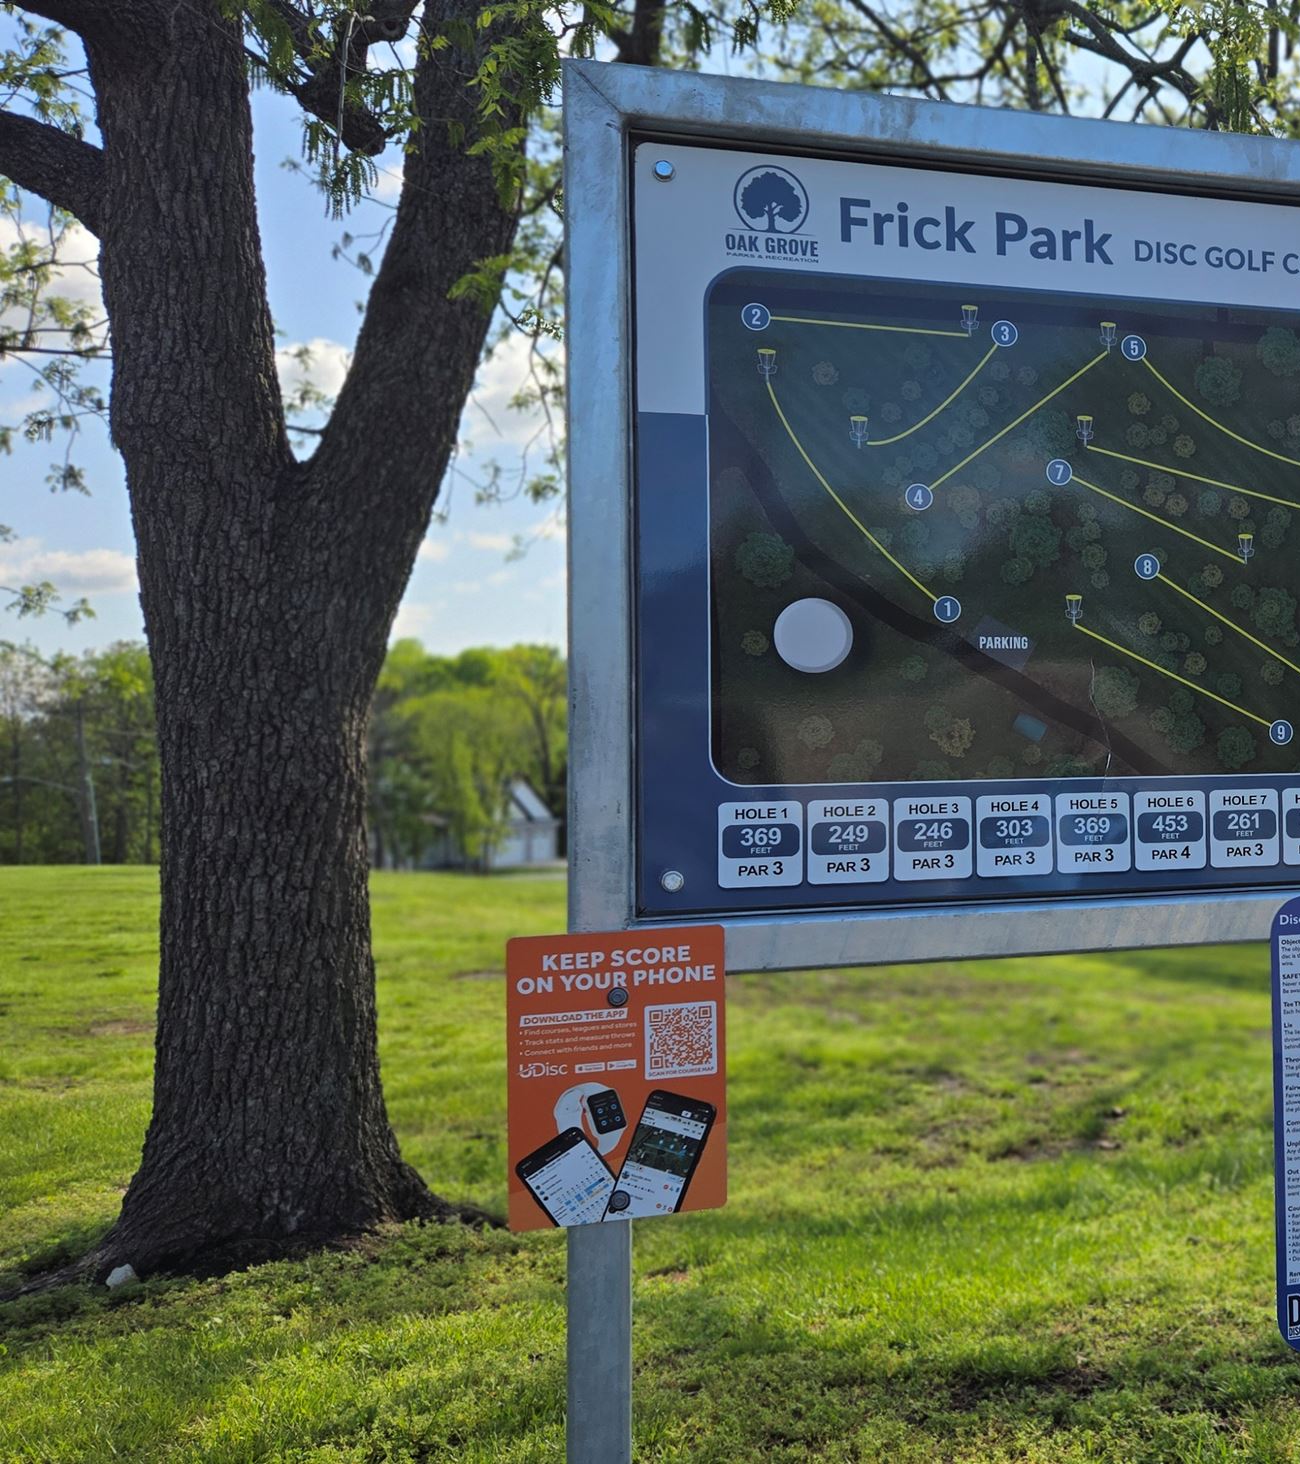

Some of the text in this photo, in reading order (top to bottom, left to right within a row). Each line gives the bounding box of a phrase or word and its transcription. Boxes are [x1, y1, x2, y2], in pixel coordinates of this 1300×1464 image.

[840, 197, 1113, 265] Frick Park
[725, 233, 818, 257] OAK GROVE
[726, 251, 755, 259] PARKS
[765, 255, 819, 264] RECREATION
[1134, 239, 1197, 266] DISC
[1205, 246, 1275, 272] GOLF
[751, 308, 761, 324] 2
[1000, 326, 1010, 342] 3
[1130, 340, 1139, 356] 5
[1055, 464, 1064, 480] 7
[914, 489, 924, 505] 4
[1143, 559, 1152, 575] 8
[944, 601, 951, 617] 1
[979, 636, 1028, 650] PARKING
[1277, 725, 1286, 741] 9
[991, 801, 1039, 812] HOLE 4
[1070, 799, 1117, 810] HOLE 5
[1148, 797, 1194, 808] HOLE 6
[1223, 795, 1267, 806] HOLE 7
[735, 808, 788, 820] HOLE 1
[823, 805, 876, 817] HOLE 2
[909, 803, 959, 815] HOLE 3
[996, 820, 1033, 837] 303
[1074, 818, 1110, 835] 369
[1152, 815, 1188, 832] 453
[1228, 813, 1260, 830] 261
[740, 827, 782, 846] 369
[828, 825, 869, 843] 249
[914, 822, 953, 840] 246
[1161, 832, 1180, 840] FEET
[995, 852, 1035, 865] PAR 3
[1074, 849, 1114, 862] PAR 3
[1152, 846, 1191, 860] PAR 4
[1226, 844, 1263, 857] PAR 3
[738, 861, 784, 876] PAR 3
[827, 858, 870, 872] PAR 3
[912, 855, 954, 869] PAR 3
[542, 946, 690, 971] KEEP SCORE
[516, 965, 716, 995] ON YOUR PHONE
[523, 1010, 625, 1025] DOWNLOAD THE APP
[518, 1062, 567, 1078] UDisc
